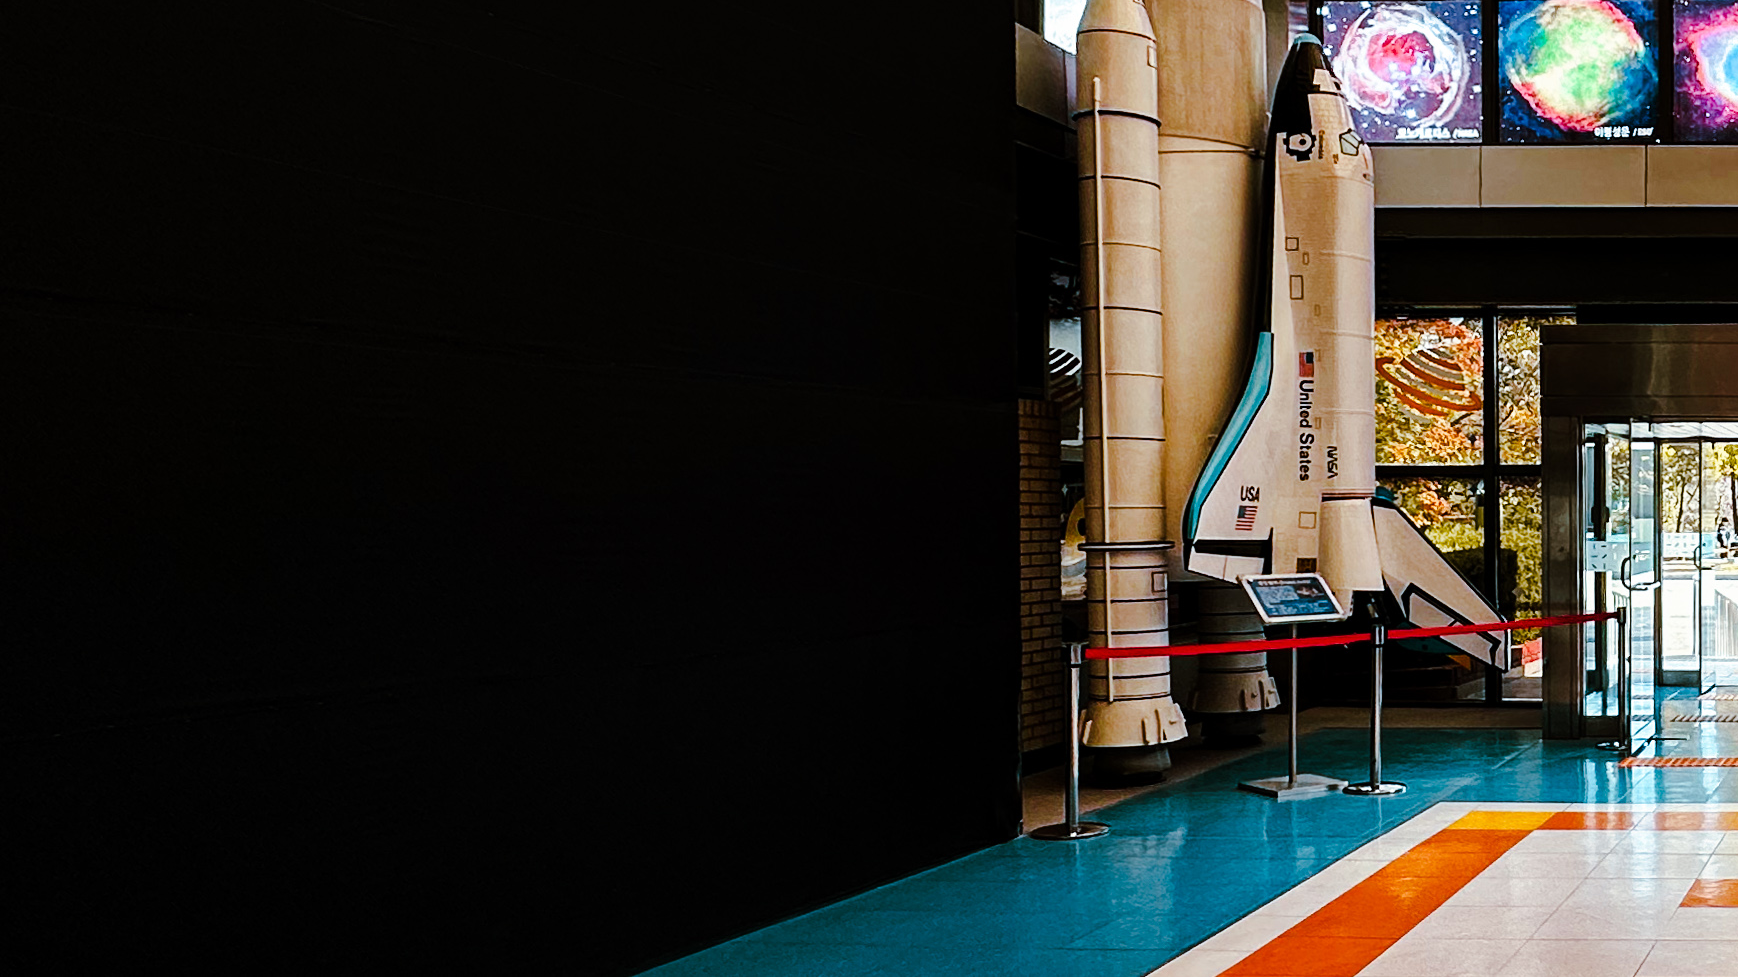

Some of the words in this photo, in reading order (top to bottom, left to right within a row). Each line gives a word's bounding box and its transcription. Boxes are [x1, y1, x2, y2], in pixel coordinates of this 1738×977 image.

[1298, 379, 1315, 429] United
[1298, 432, 1315, 482] States
[1326, 445, 1338, 480] NASA
[1240, 485, 1260, 503] USA
